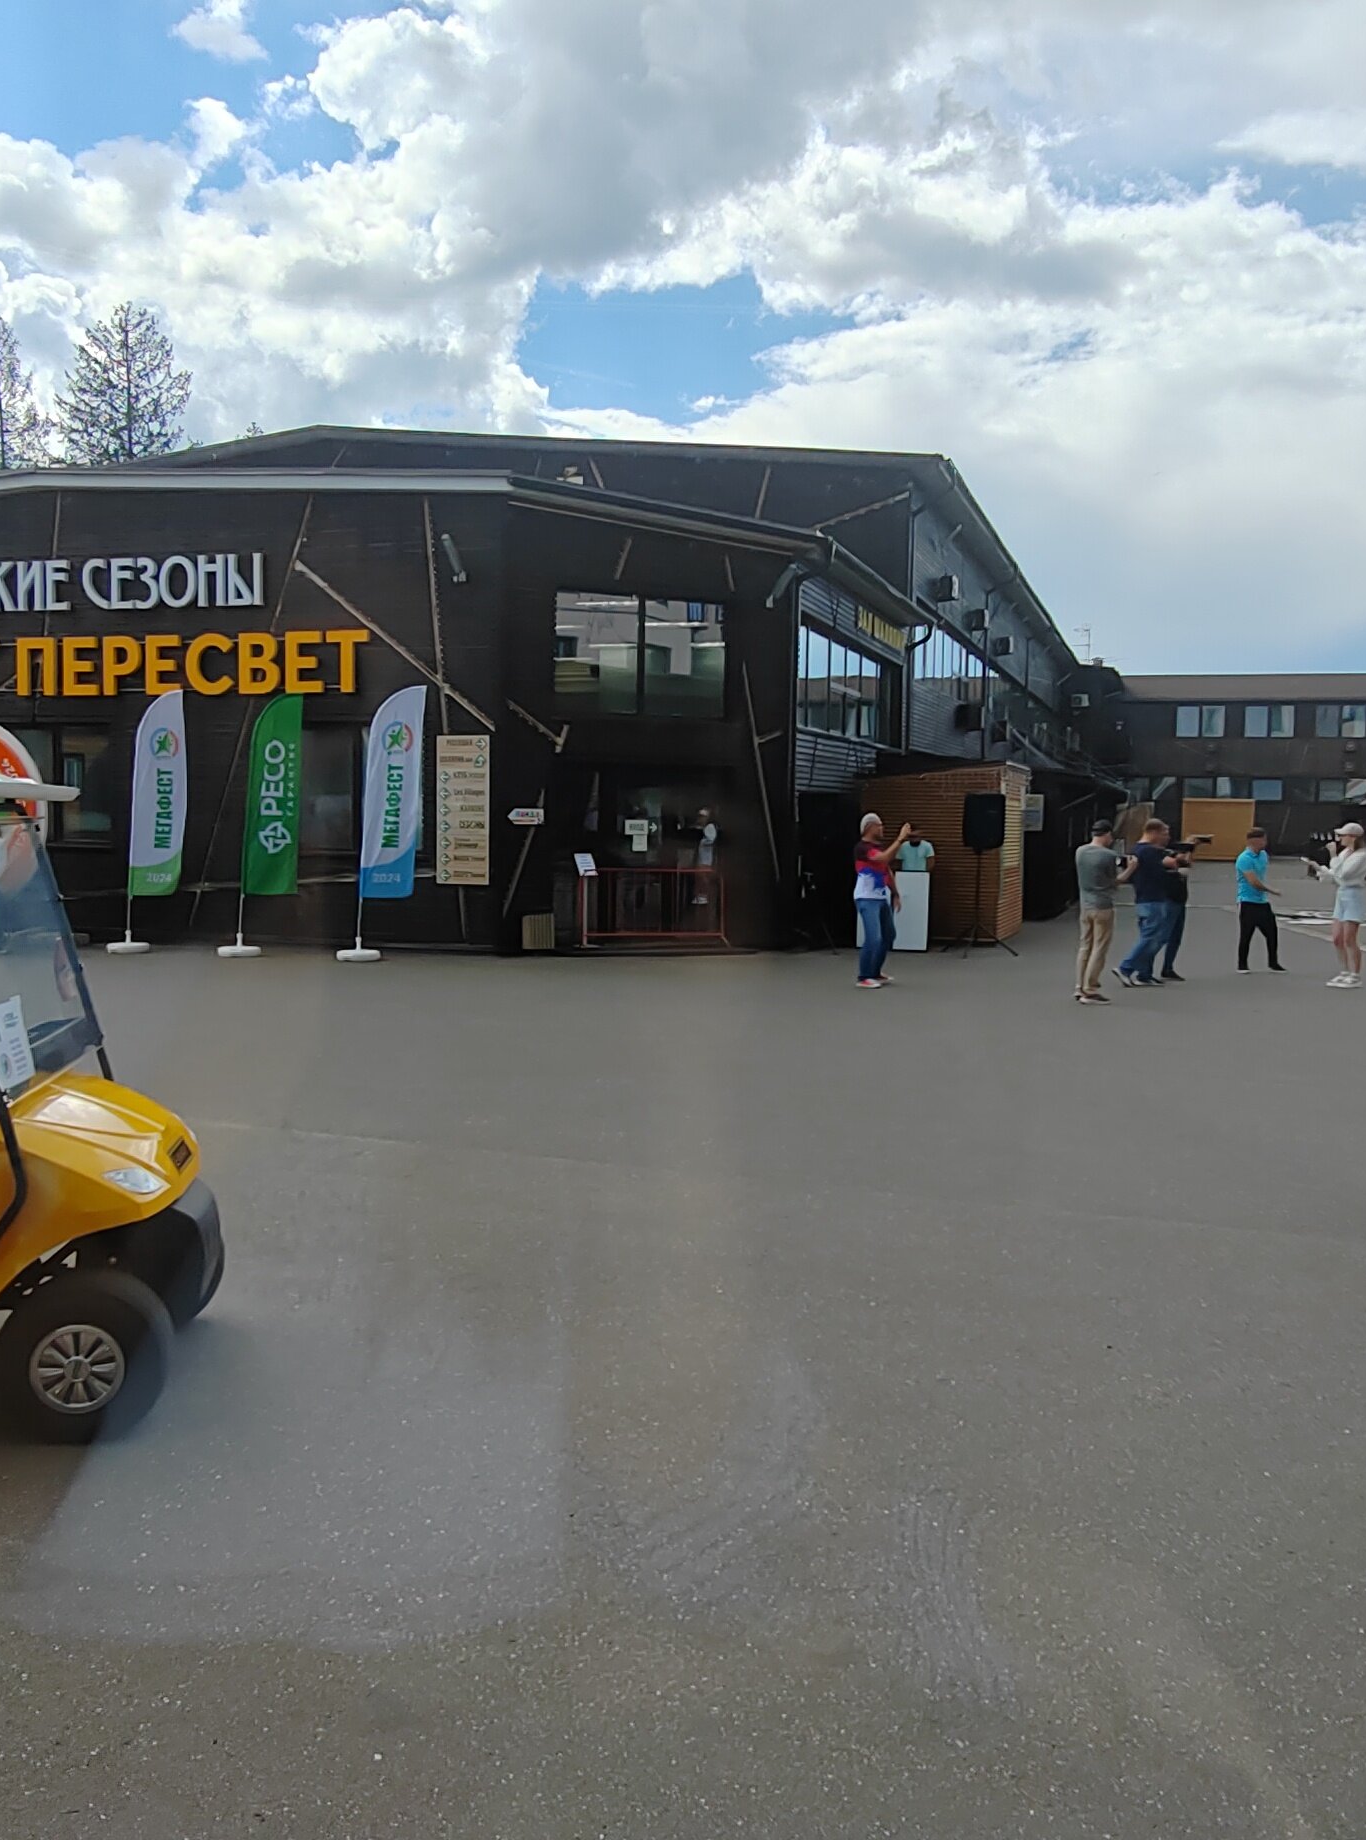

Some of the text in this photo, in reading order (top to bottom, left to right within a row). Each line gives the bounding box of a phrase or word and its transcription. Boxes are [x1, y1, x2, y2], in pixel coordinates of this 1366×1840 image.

[82, 552, 265, 610] СЕЗОНЫ
[16, 628, 372, 697] ПЕРЕСВЕТ
[154, 768, 174, 849] МЕГАФЕСТ
[260, 739, 286, 817] РЕСО
[381, 764, 404, 848] МЕГАФЕСТ
[146, 872, 172, 883] 2024
[372, 872, 401, 883] 2024
